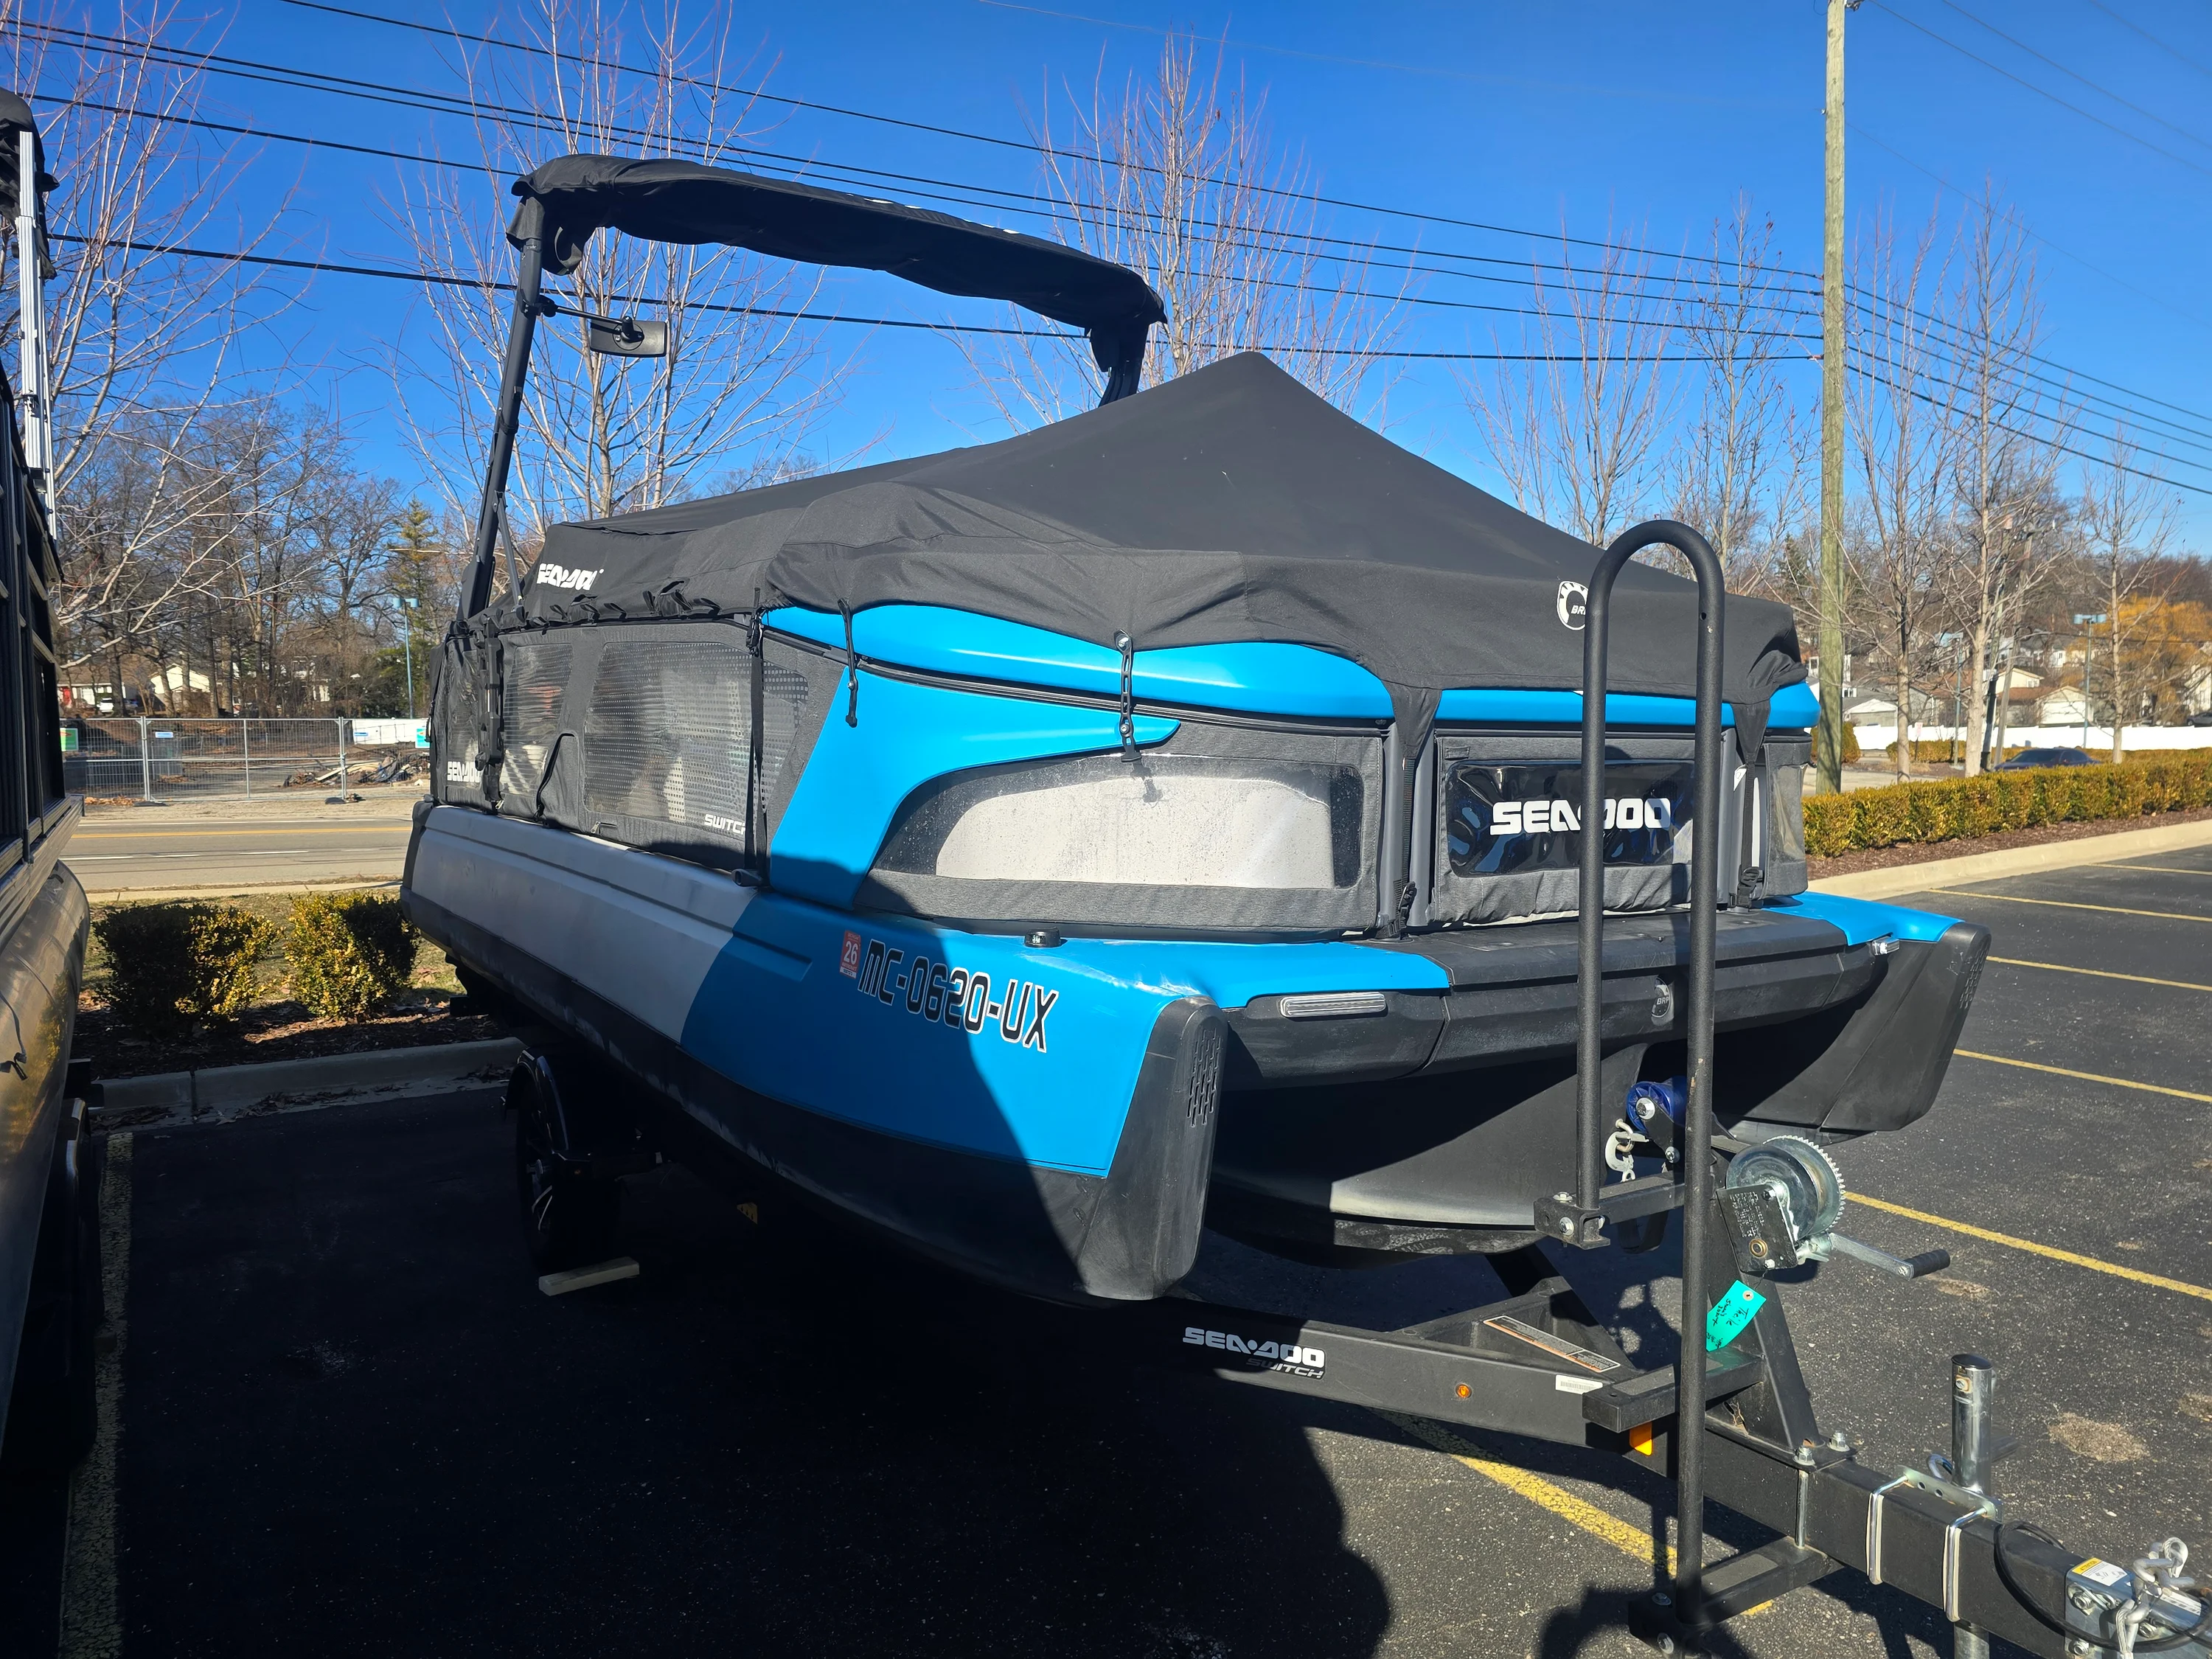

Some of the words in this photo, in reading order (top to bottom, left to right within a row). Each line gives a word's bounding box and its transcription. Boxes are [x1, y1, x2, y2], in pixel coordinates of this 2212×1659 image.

[843, 940, 859, 965] 26
[1656, 996, 1670, 1006] BRP
[1246, 1357, 1325, 1379] SWITCH
